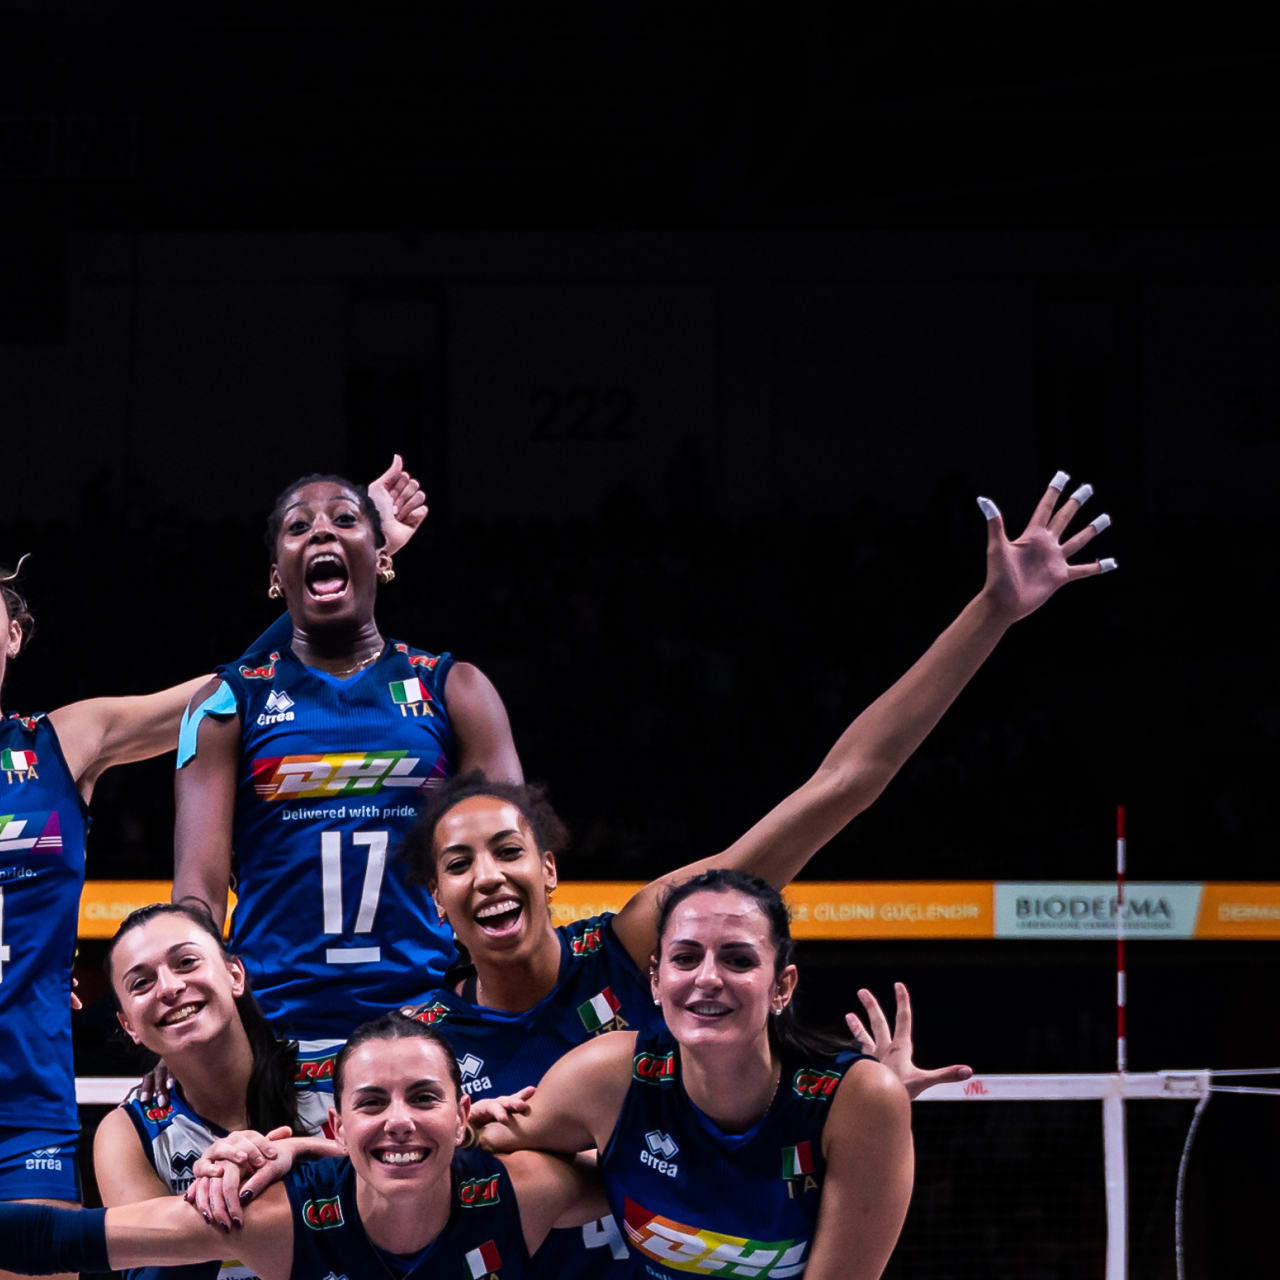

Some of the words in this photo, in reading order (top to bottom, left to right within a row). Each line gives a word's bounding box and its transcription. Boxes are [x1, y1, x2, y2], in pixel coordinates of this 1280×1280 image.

[400, 703, 435, 718] ITA
[7, 765, 39, 784] ITA
[277, 758, 426, 793] DHL
[282, 807, 346, 821] Delivered
[349, 805, 380, 819] with
[382, 805, 418, 820] pride.
[321, 831, 389, 934] 17
[462, 1076, 492, 1094] rrea
